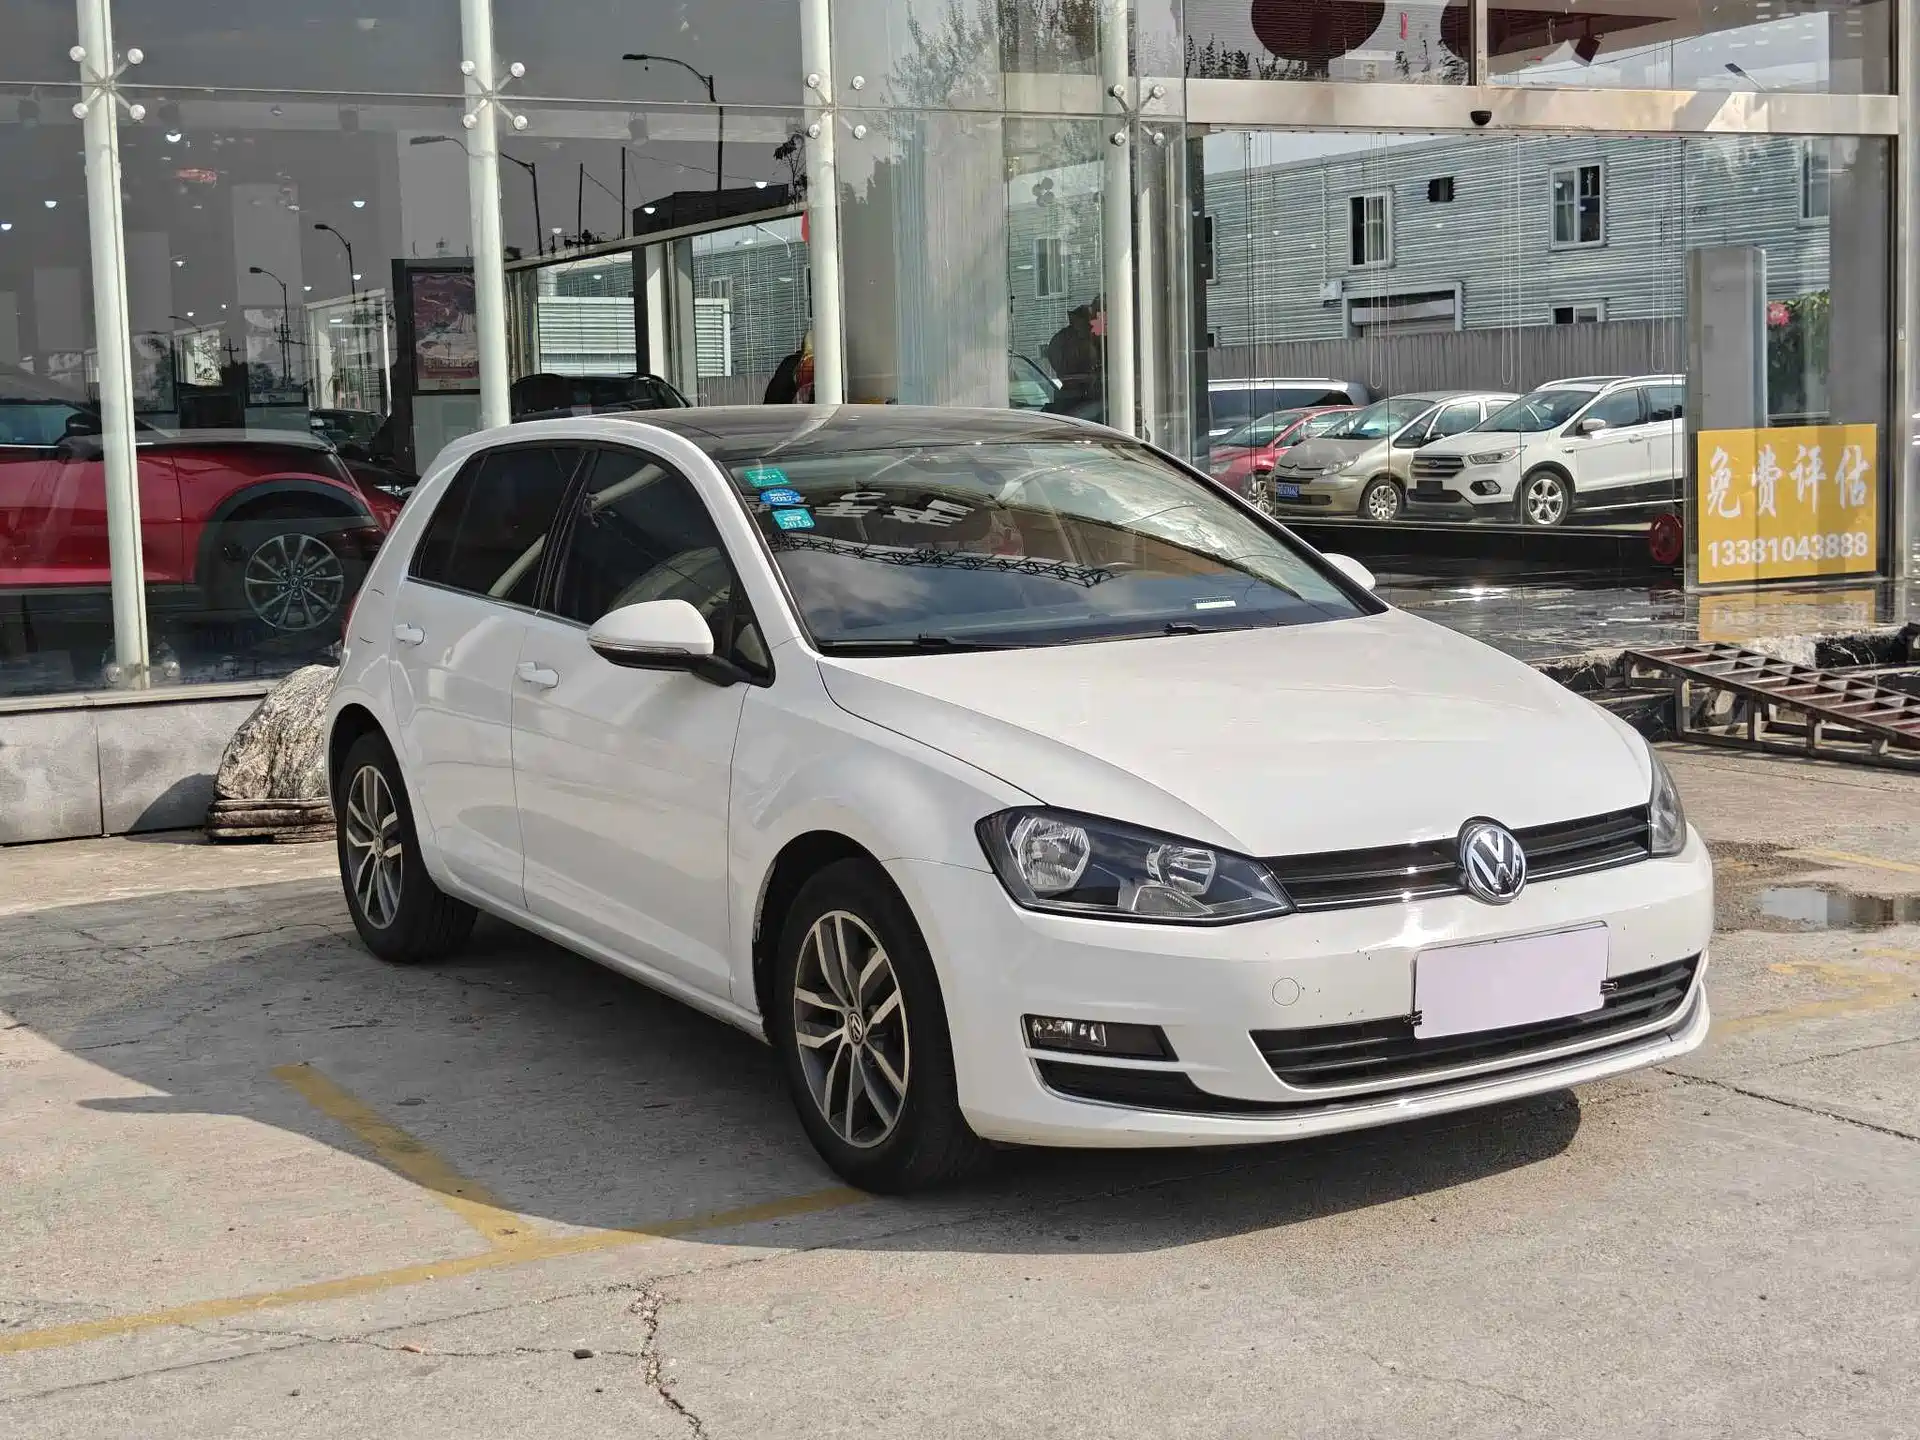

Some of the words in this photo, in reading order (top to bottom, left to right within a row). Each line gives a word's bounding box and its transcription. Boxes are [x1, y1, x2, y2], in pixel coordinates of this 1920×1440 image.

[1707, 444, 1871, 518] 免费评估
[1708, 532, 1868, 568] 13381043888
